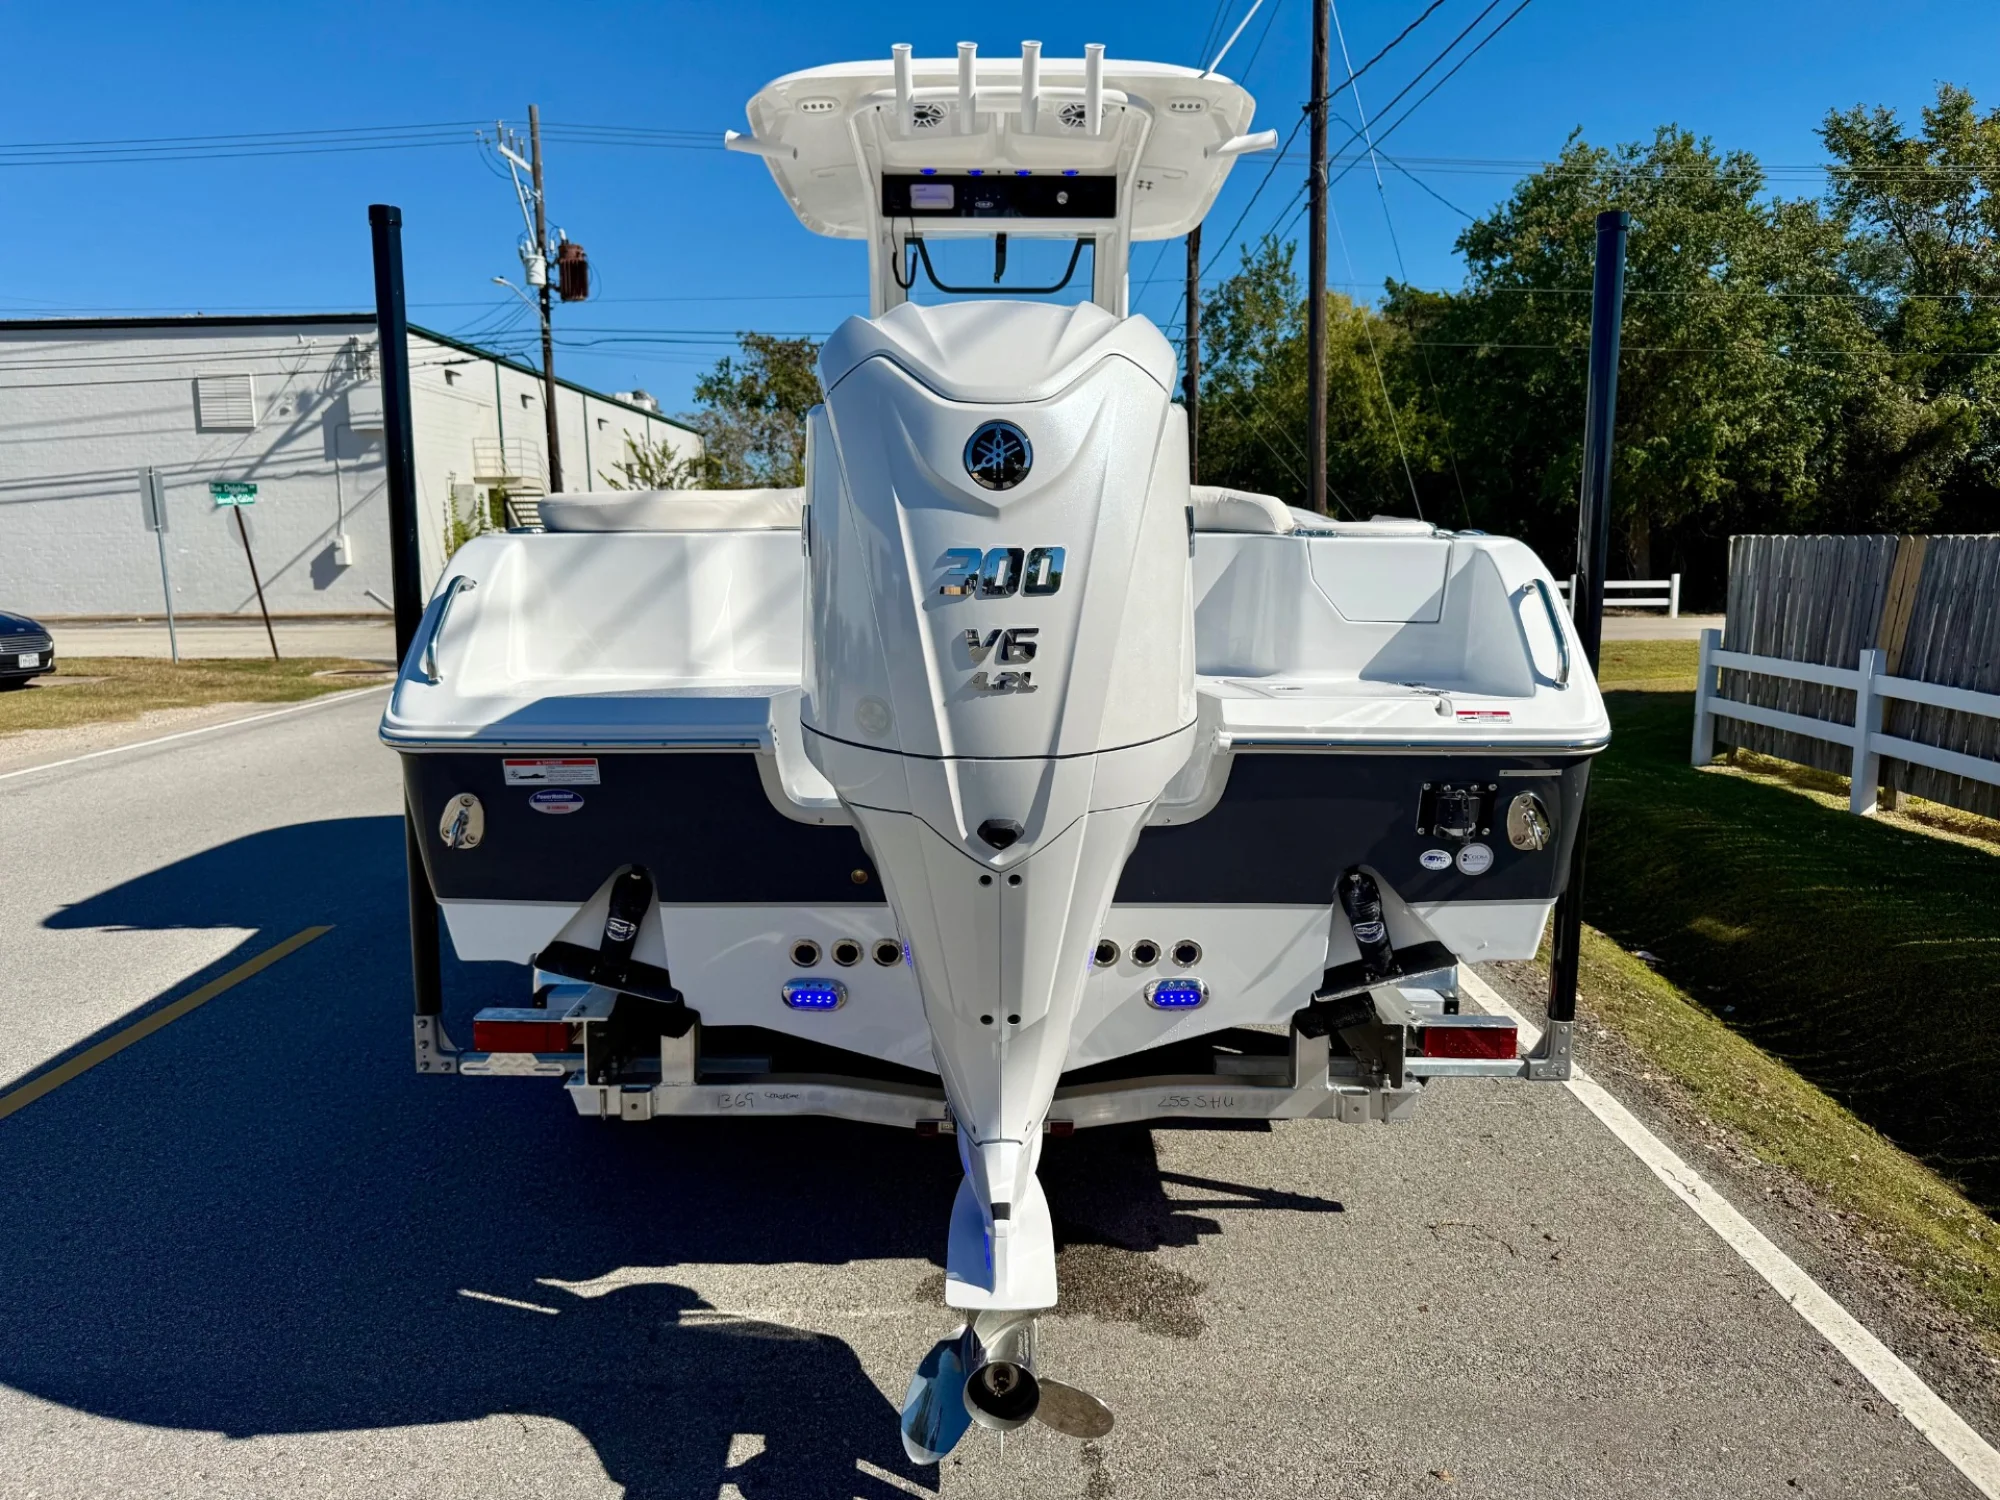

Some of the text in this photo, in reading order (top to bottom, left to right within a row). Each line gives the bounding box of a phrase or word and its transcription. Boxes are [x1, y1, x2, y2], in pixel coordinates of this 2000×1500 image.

[225, 484, 249, 494] Dolphin
[939, 547, 1065, 599] 300
[964, 627, 1039, 666] V6
[969, 672, 1038, 694] 4.2L
